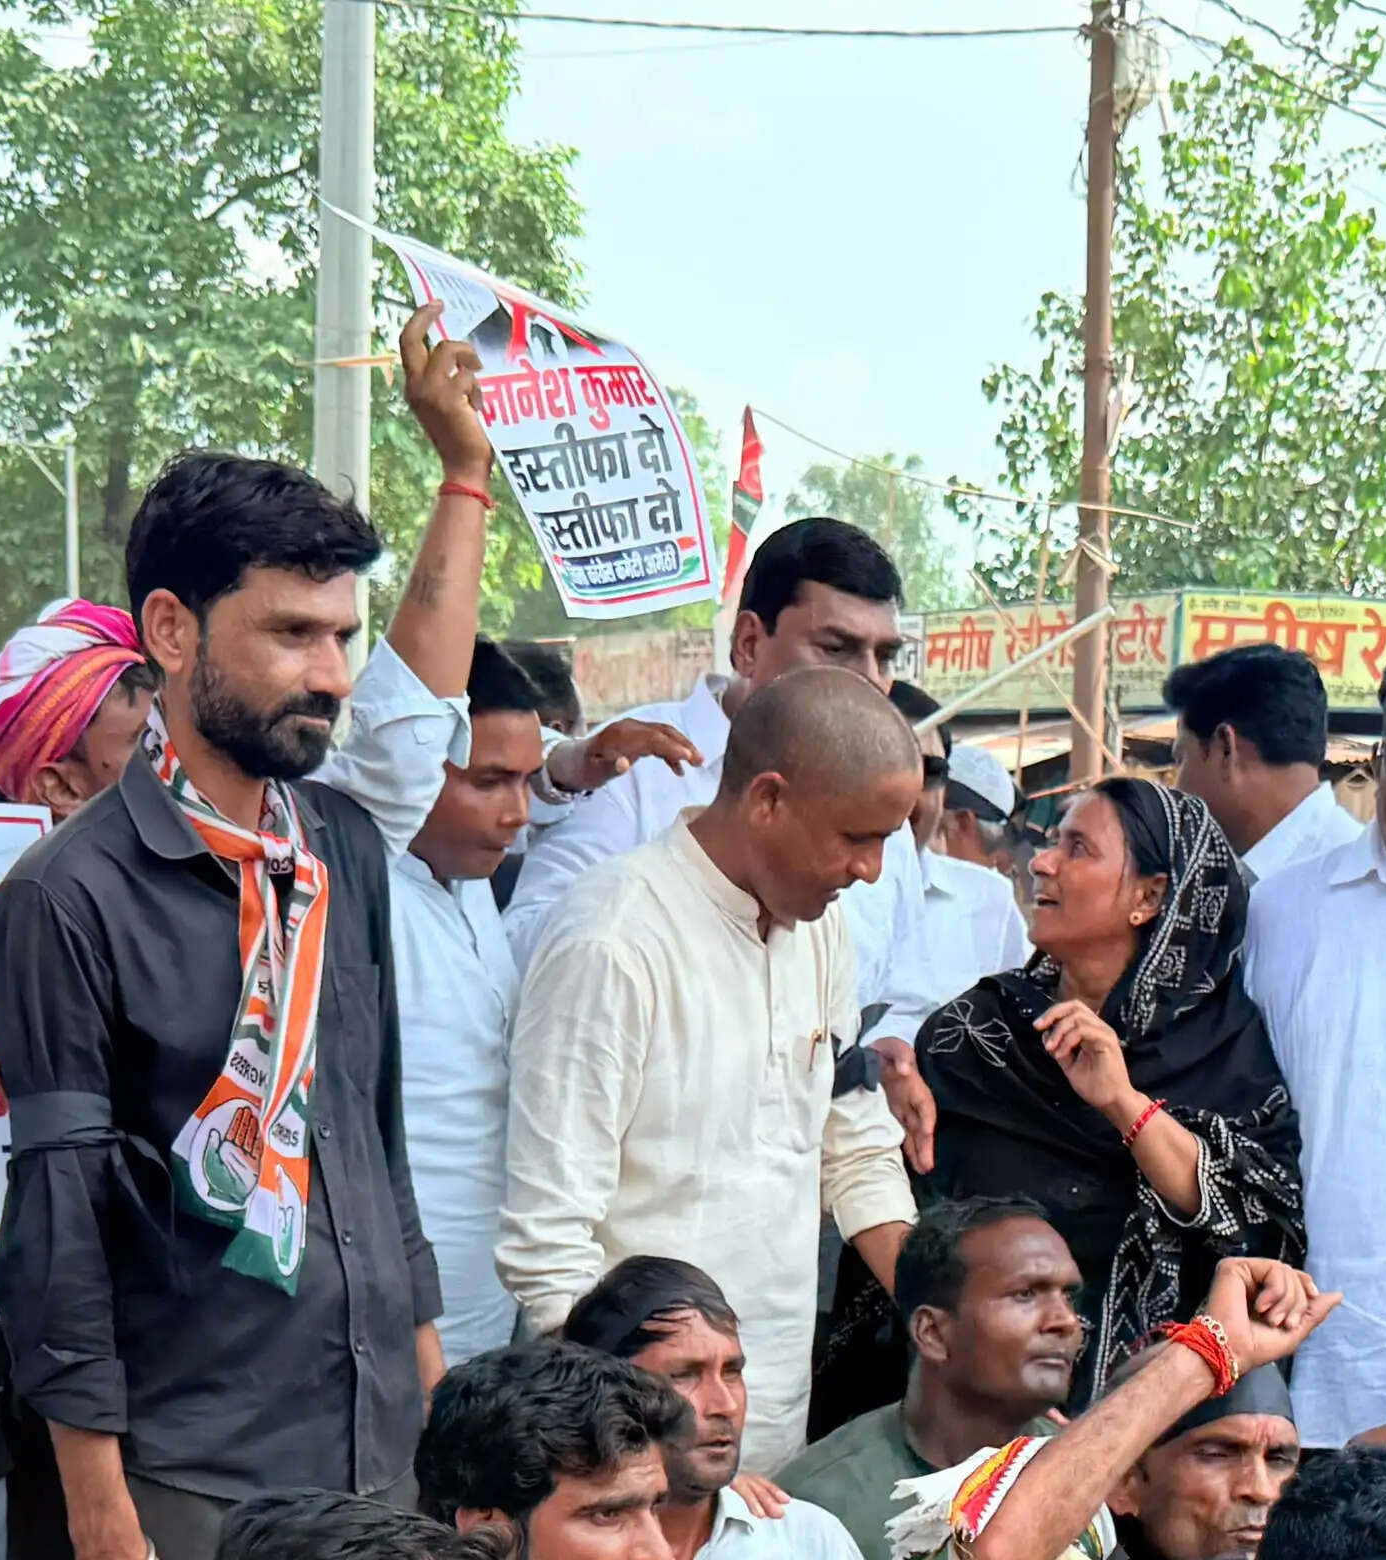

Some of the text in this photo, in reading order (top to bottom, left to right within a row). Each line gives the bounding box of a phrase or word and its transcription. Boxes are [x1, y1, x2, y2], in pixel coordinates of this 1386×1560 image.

[574, 365, 657, 430] कुमार
[502, 414, 673, 495] इस्तीफा दो
[641, 478, 683, 534] दो
[926, 616, 994, 673] मनीष
